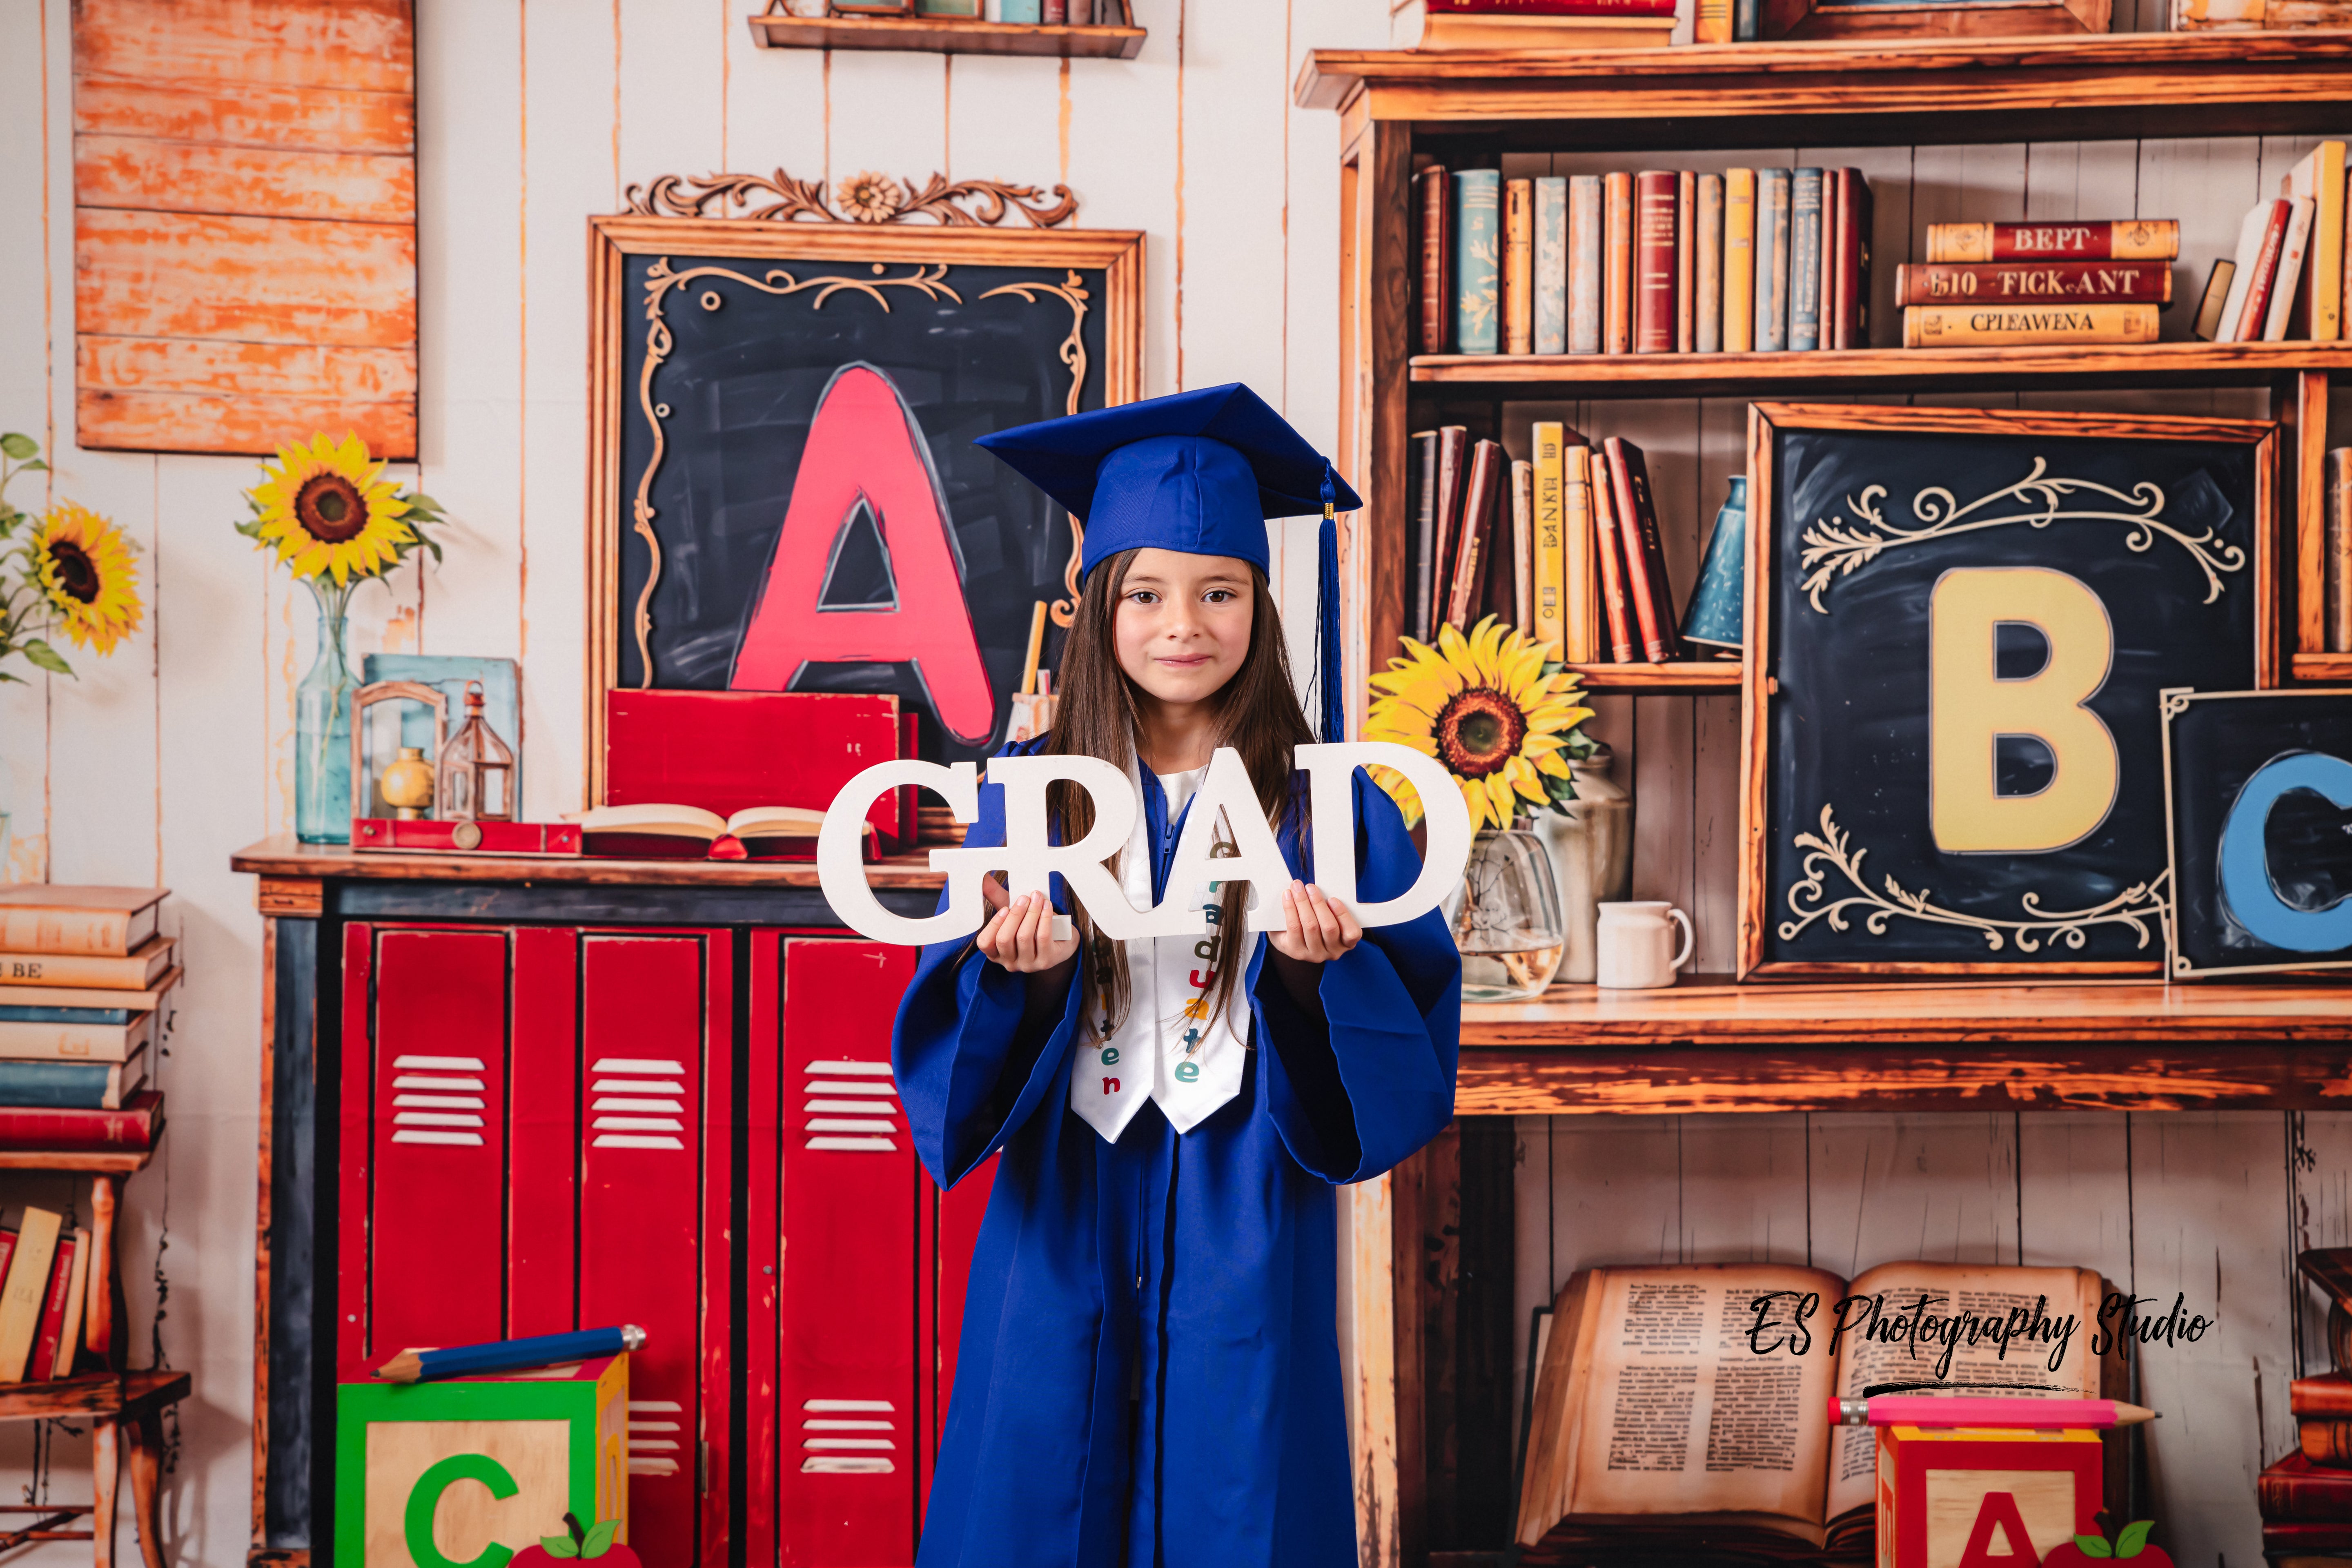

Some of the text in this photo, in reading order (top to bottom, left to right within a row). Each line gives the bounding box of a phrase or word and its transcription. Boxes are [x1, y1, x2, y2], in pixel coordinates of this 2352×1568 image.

[729, 361, 996, 746] A
[1929, 566, 2120, 855] B
[817, 742, 1471, 945] GRAD
[2216, 749, 2352, 952] C
[404, 1453, 519, 1568] C
[1958, 1491, 2042, 1568] A
